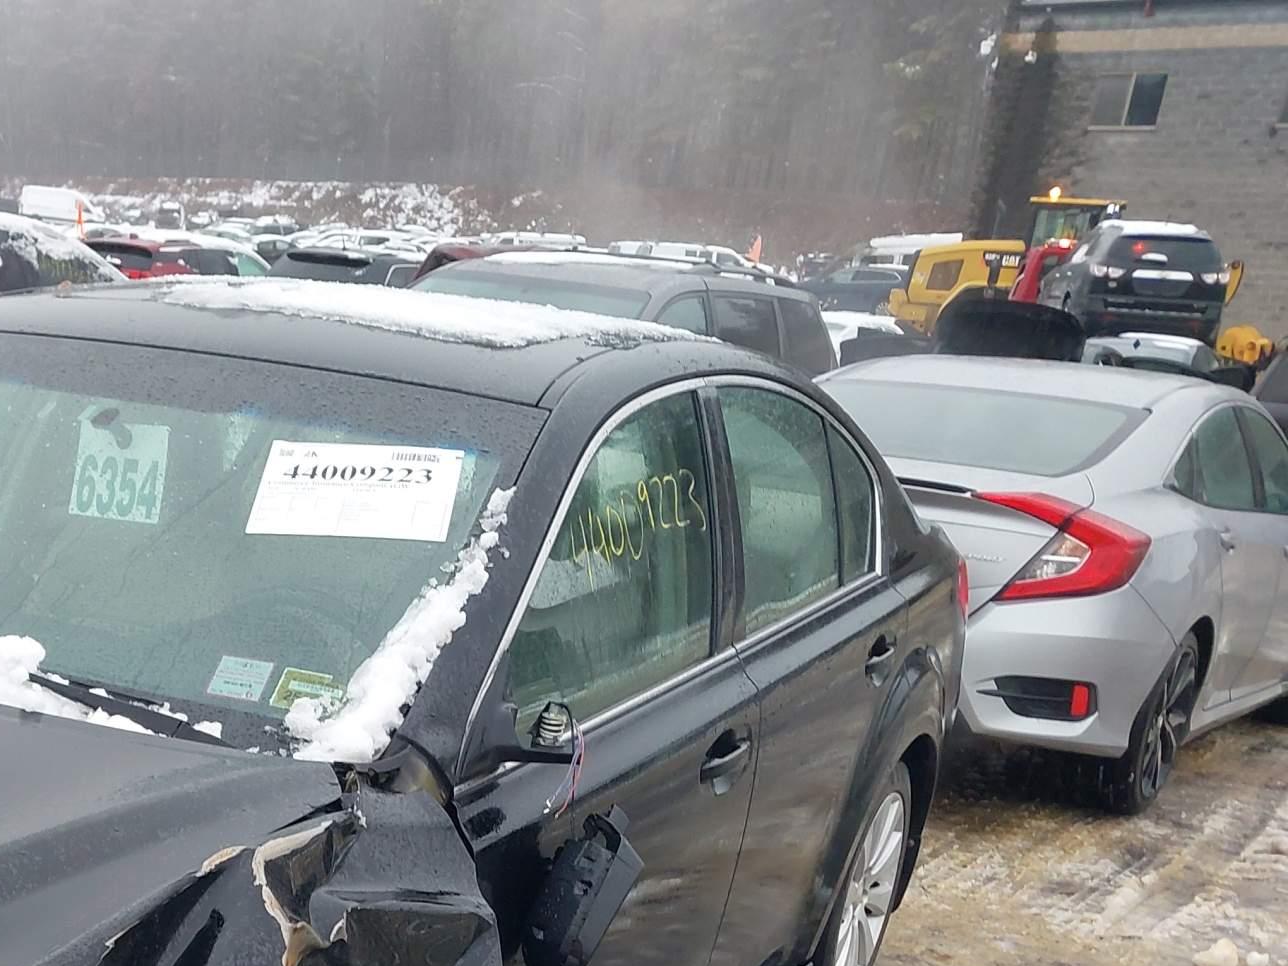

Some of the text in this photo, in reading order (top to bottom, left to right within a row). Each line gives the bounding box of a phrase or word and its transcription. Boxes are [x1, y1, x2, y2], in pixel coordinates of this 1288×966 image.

[1002, 254, 1021, 267] CAT
[76, 454, 159, 519] 6354
[283, 463, 433, 485] 44009223
[569, 468, 707, 592] 44009223
